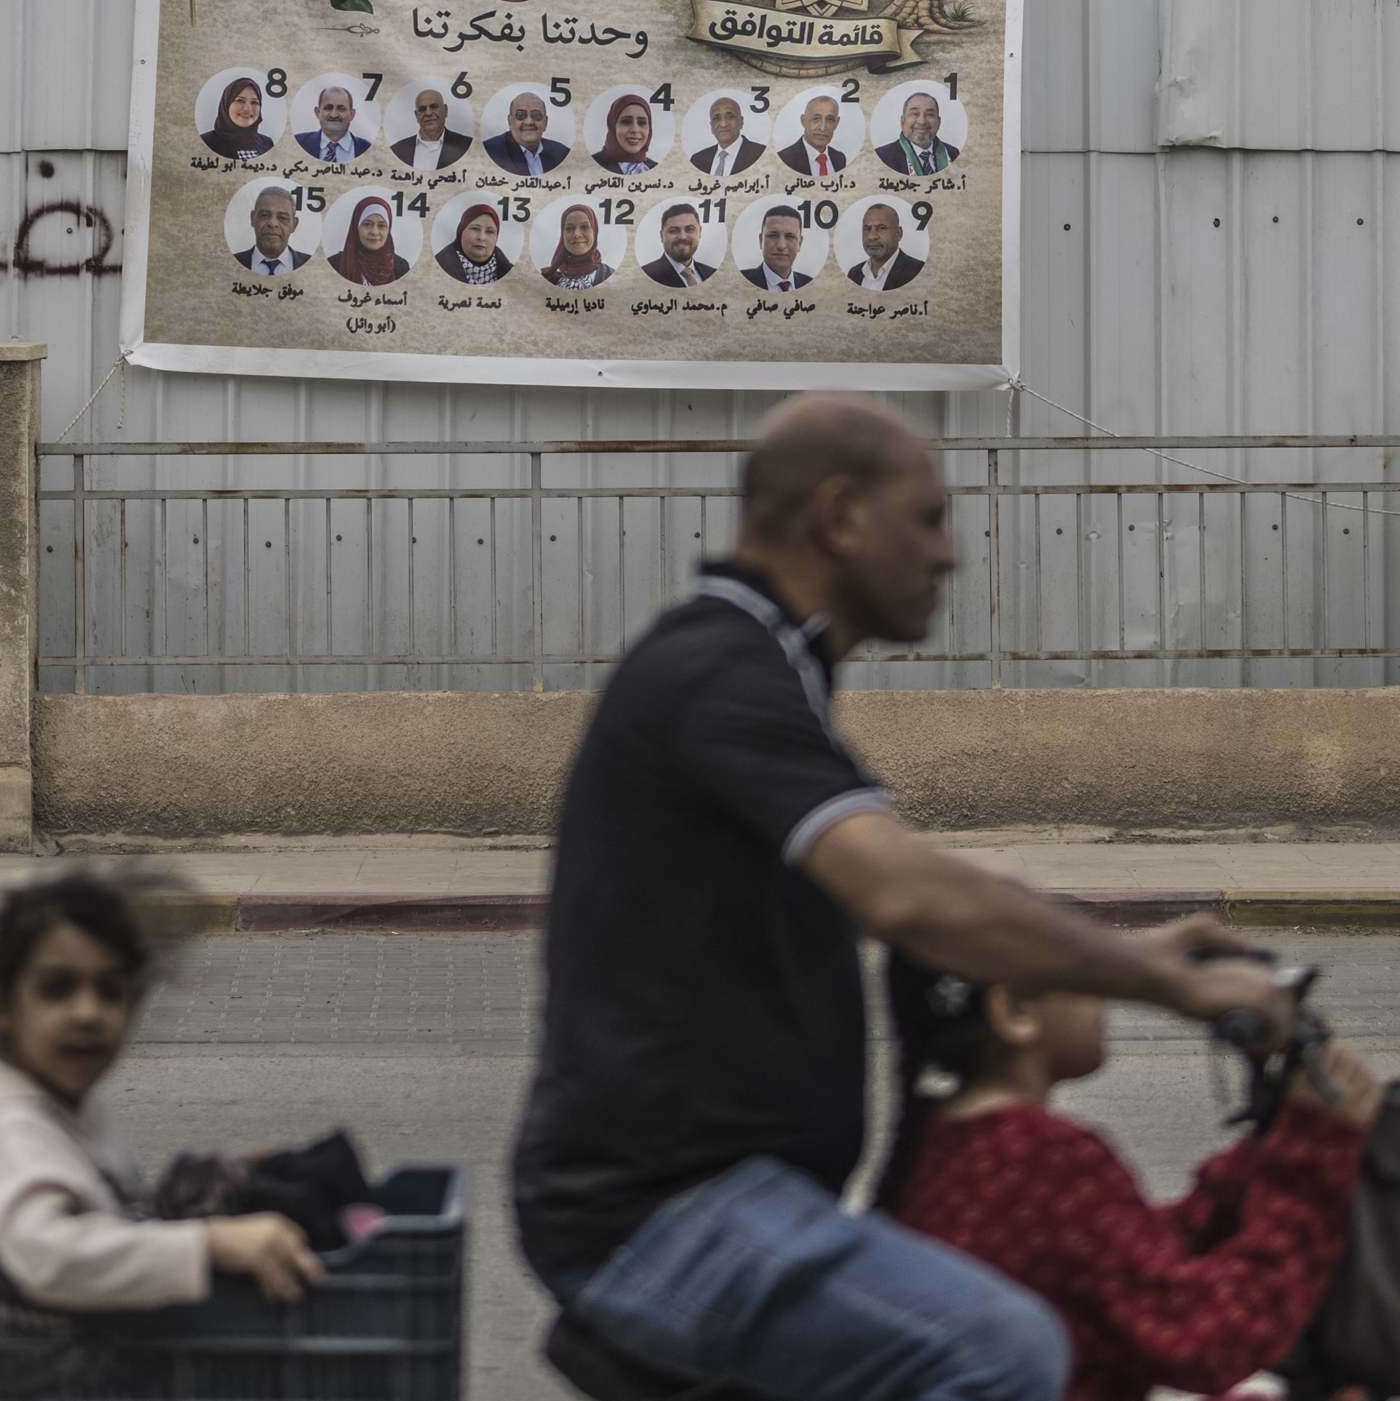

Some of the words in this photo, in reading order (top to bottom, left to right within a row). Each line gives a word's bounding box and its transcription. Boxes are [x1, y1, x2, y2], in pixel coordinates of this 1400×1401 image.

[411, 8, 526, 52] بفكرتنا
[542, 13, 649, 59] وحدتنا
[709, 9, 814, 47] التوافق
[818, 23, 883, 46] قائمة
[266, 68, 287, 98] 8
[362, 73, 383, 101] 7
[451, 72, 472, 99] 6
[550, 77, 571, 107] 5
[841, 78, 860, 103] 2
[944, 73, 958, 100] 1
[650, 83, 674, 111] 4
[750, 87, 770, 113] 3
[190, 156, 218, 169] لطيفة
[283, 161, 308, 178] مكي
[312, 164, 345, 177] الناصر
[391, 171, 423, 185] براهمة
[475, 176, 508, 188] خشان
[585, 177, 624, 194] القاضي
[688, 179, 720, 195] غروف
[785, 177, 816, 195] عناني
[879, 177, 920, 191] جلايطة
[291, 187, 326, 212] 15
[391, 191, 430, 218] 14
[498, 197, 531, 222] 13
[599, 199, 635, 224] 12
[699, 199, 726, 223] 11
[798, 200, 838, 229] 10
[911, 201, 933, 231] 9
[232, 283, 272, 298] جلايطة
[278, 286, 304, 300] موفق
[338, 290, 372, 307] غروف
[375, 291, 408, 306] أسماء
[438, 296, 472, 311] نصرية
[477, 297, 502, 309] نعمة
[584, 299, 605, 310] ناديا
[631, 299, 677, 315] الريماوي
[682, 301, 728, 316] م.محمد
[747, 299, 778, 319] صافي
[784, 299, 815, 319] صافي
[847, 303, 886, 319] عواجنة
